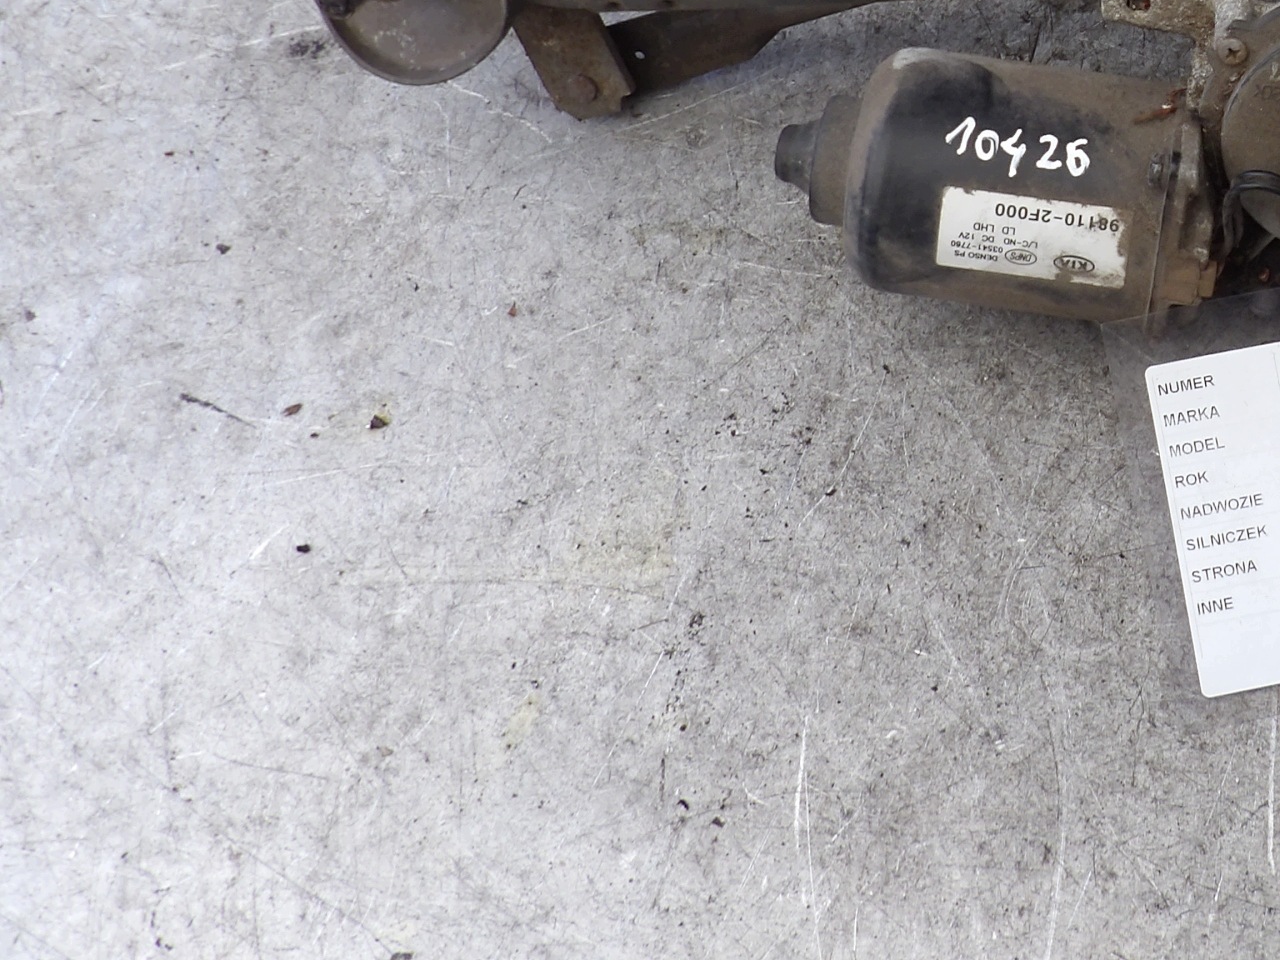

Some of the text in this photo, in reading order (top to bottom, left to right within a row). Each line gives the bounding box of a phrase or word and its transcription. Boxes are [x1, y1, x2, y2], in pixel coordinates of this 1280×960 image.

[945, 116, 1091, 177] 10426
[973, 222, 1016, 235] LD LHD
[995, 203, 1120, 232] 98110-2F000
[958, 232, 975, 240] 12V
[981, 234, 995, 243] DC
[954, 249, 998, 262] DENSO PS
[1060, 258, 1088, 270] KIA
[1157, 374, 1215, 396] NUMER
[1163, 405, 1220, 427] MARKA
[1169, 436, 1225, 458] MODEL
[1174, 471, 1209, 489] ROK
[1180, 493, 1263, 521] NADWOZIE
[1186, 525, 1267, 551] SILNICZEK
[1191, 559, 1258, 583] STRONA
[1197, 597, 1234, 616] INNE
